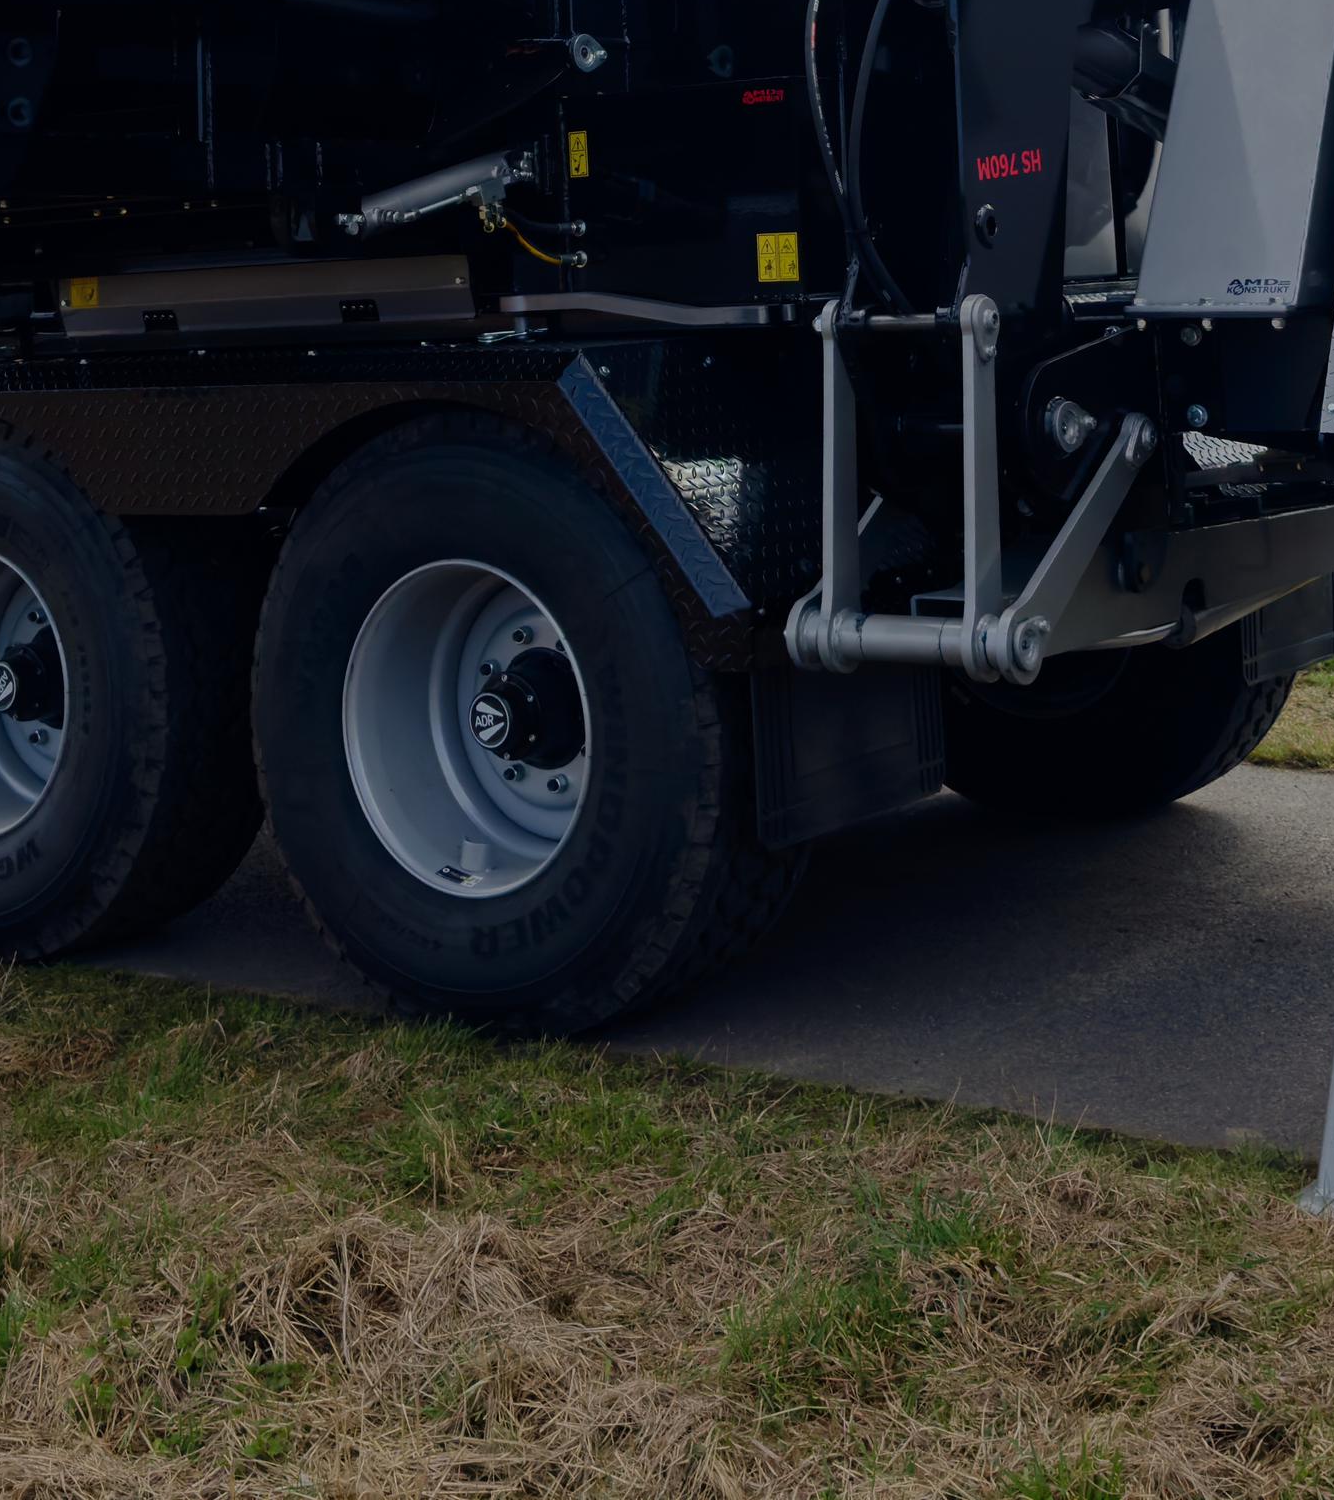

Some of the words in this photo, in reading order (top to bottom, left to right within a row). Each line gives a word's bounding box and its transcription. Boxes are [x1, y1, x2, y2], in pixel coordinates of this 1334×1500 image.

[976, 152, 1019, 181] 760M
[1021, 148, 1042, 174] HS
[1227, 285, 1289, 295] KONSTRUKT
[475, 714, 494, 728] ADR
